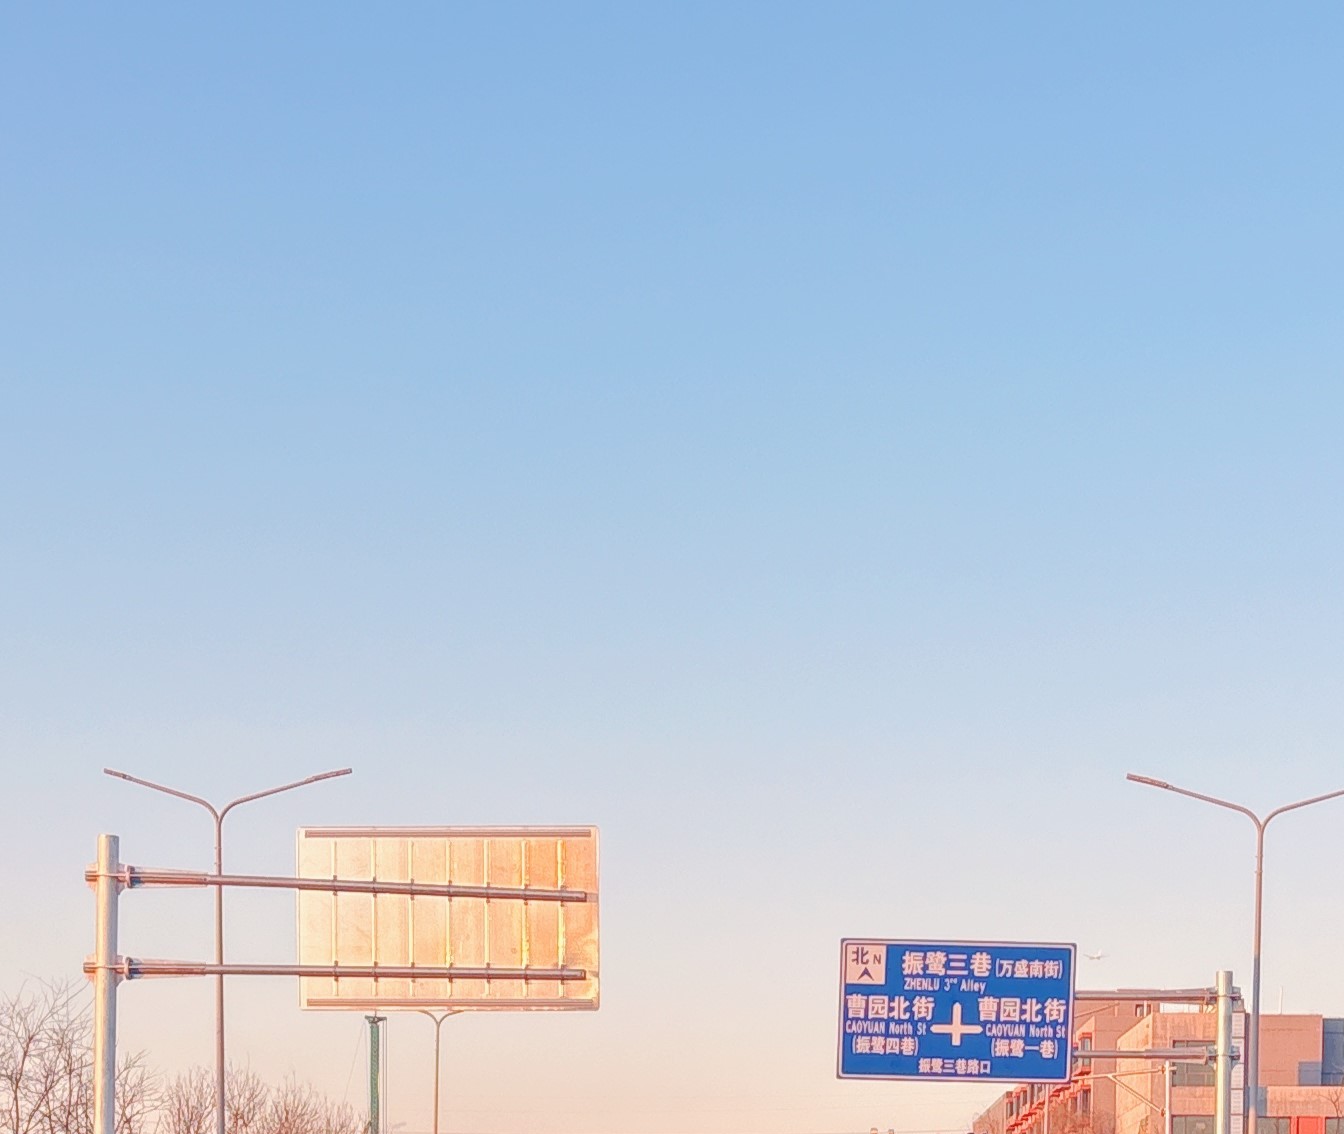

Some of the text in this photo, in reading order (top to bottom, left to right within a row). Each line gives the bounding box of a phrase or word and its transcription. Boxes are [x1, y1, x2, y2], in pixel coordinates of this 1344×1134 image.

[852, 947, 869, 965] 北
[873, 954, 882, 965] N
[902, 951, 1063, 979] 振鹭三巷 (万盛南街)
[904, 978, 986, 995] ZHENLU 3rd Alley
[846, 994, 935, 1021] 曹园北街
[978, 996, 1067, 1023] 曹园北街
[846, 1021, 927, 1036] CAOYUAN North St
[986, 1024, 1066, 1039] CAOYUAN North St
[852, 1035, 919, 1056] (振鹭四巷)
[991, 1038, 1058, 1059] (振鹭一巷)
[919, 1058, 991, 1075] 振鹭三巷路口
